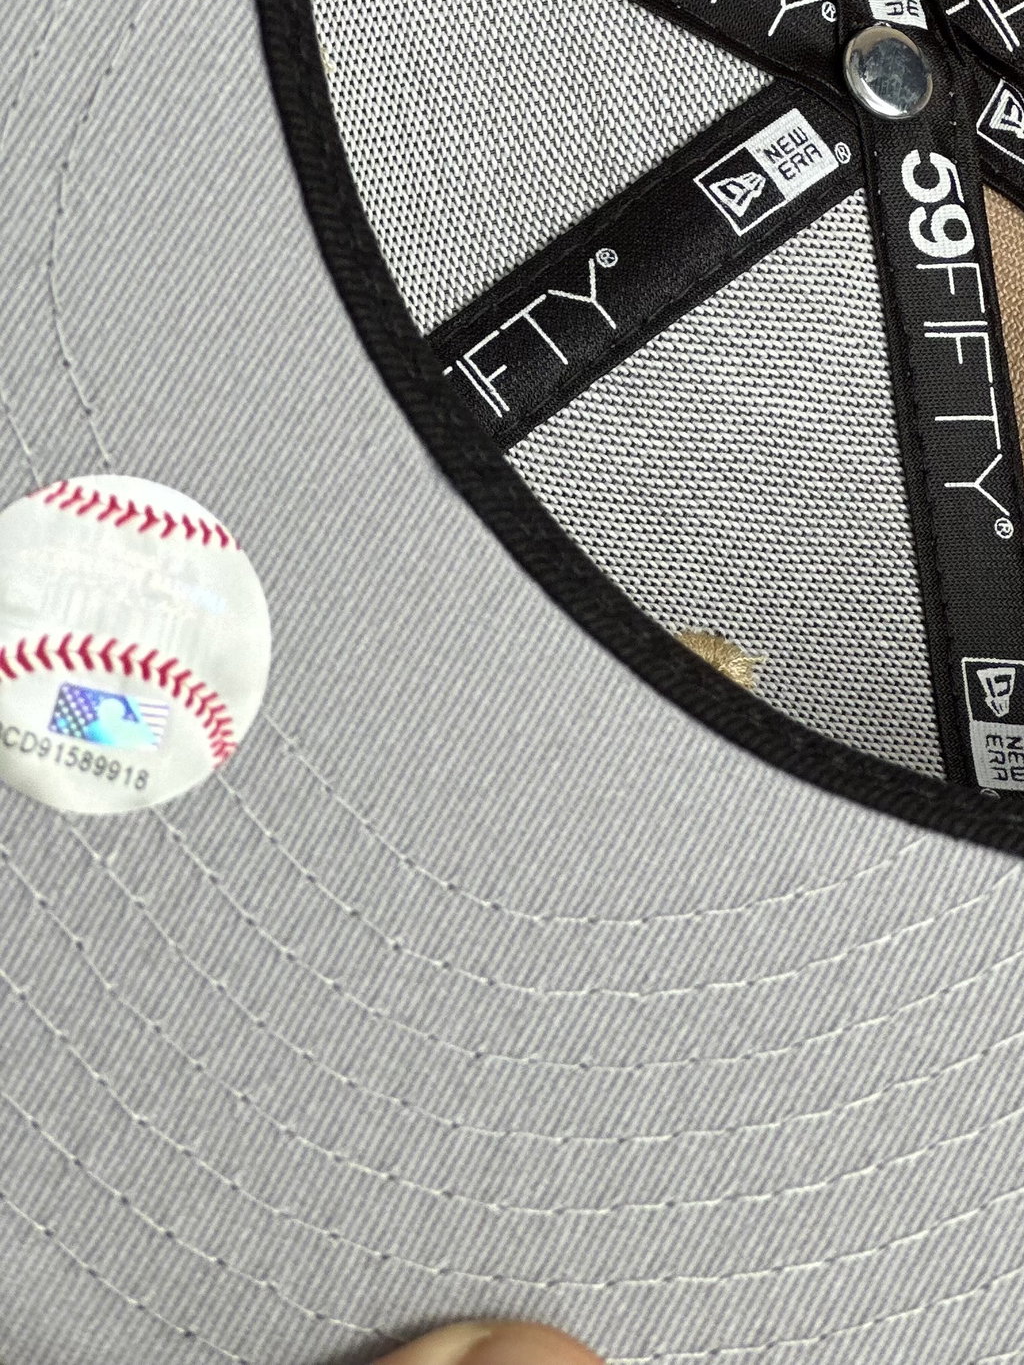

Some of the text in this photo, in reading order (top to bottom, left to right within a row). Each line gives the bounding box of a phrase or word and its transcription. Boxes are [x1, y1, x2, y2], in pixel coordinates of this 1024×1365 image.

[763, 127, 808, 164] NEW
[778, 143, 823, 181] ERA
[0, 722, 150, 790] CD91589918
[986, 734, 1009, 782] ERA
